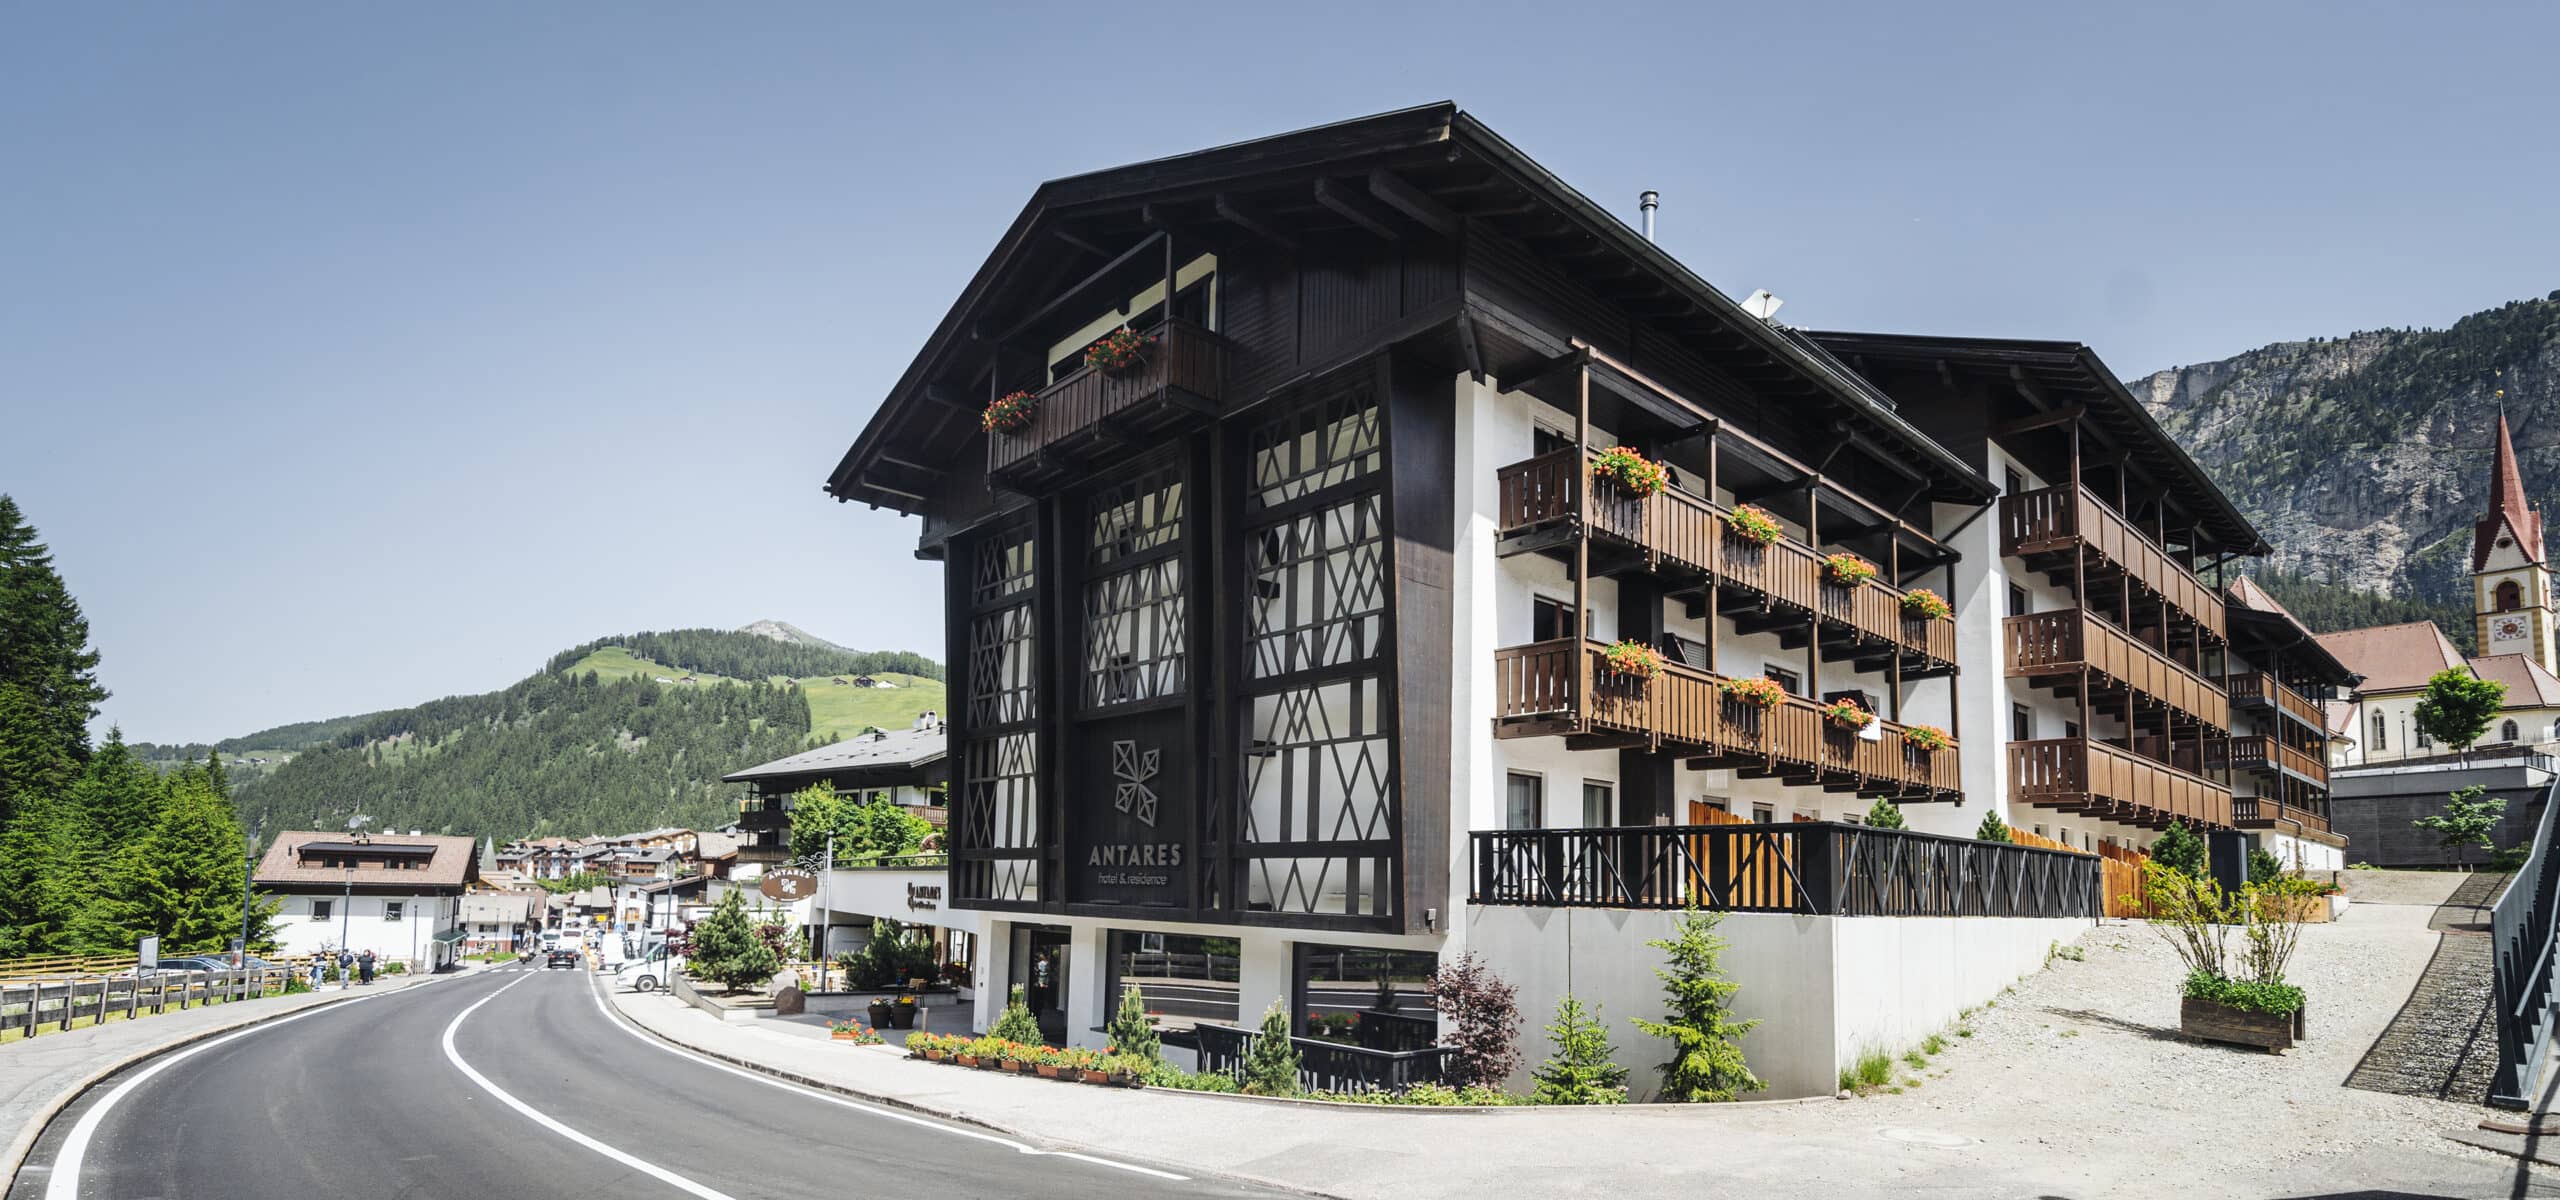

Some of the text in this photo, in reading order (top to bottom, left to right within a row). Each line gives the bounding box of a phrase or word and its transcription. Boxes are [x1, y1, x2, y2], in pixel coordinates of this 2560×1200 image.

[1088, 844, 1181, 866] ANTARES
[768, 869, 810, 880] ANTARES
[1098, 872, 1168, 885] hotel & residence
